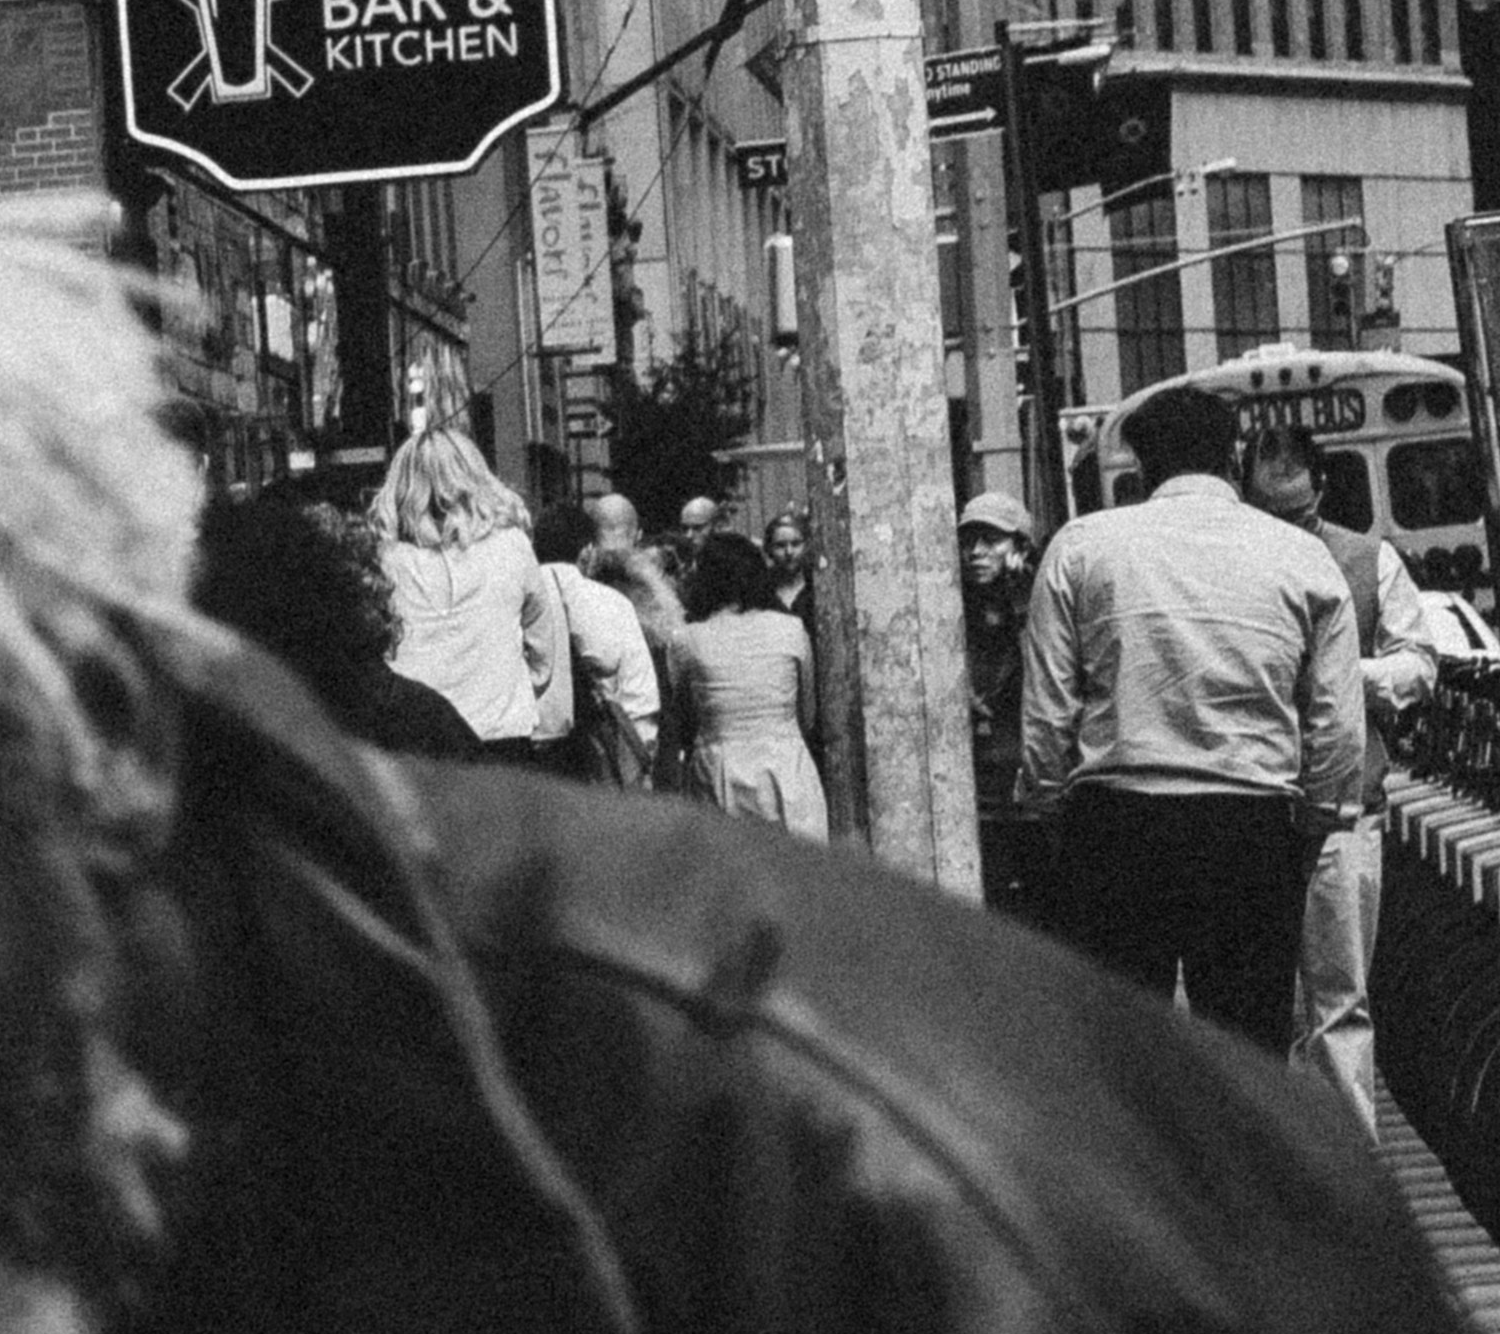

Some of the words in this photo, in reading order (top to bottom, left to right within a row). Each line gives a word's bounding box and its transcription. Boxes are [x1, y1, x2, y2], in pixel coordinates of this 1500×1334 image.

[326, 21, 518, 71] KITCHEN
[936, 55, 1002, 81] STANDING
[1313, 391, 1362, 429] BUS
